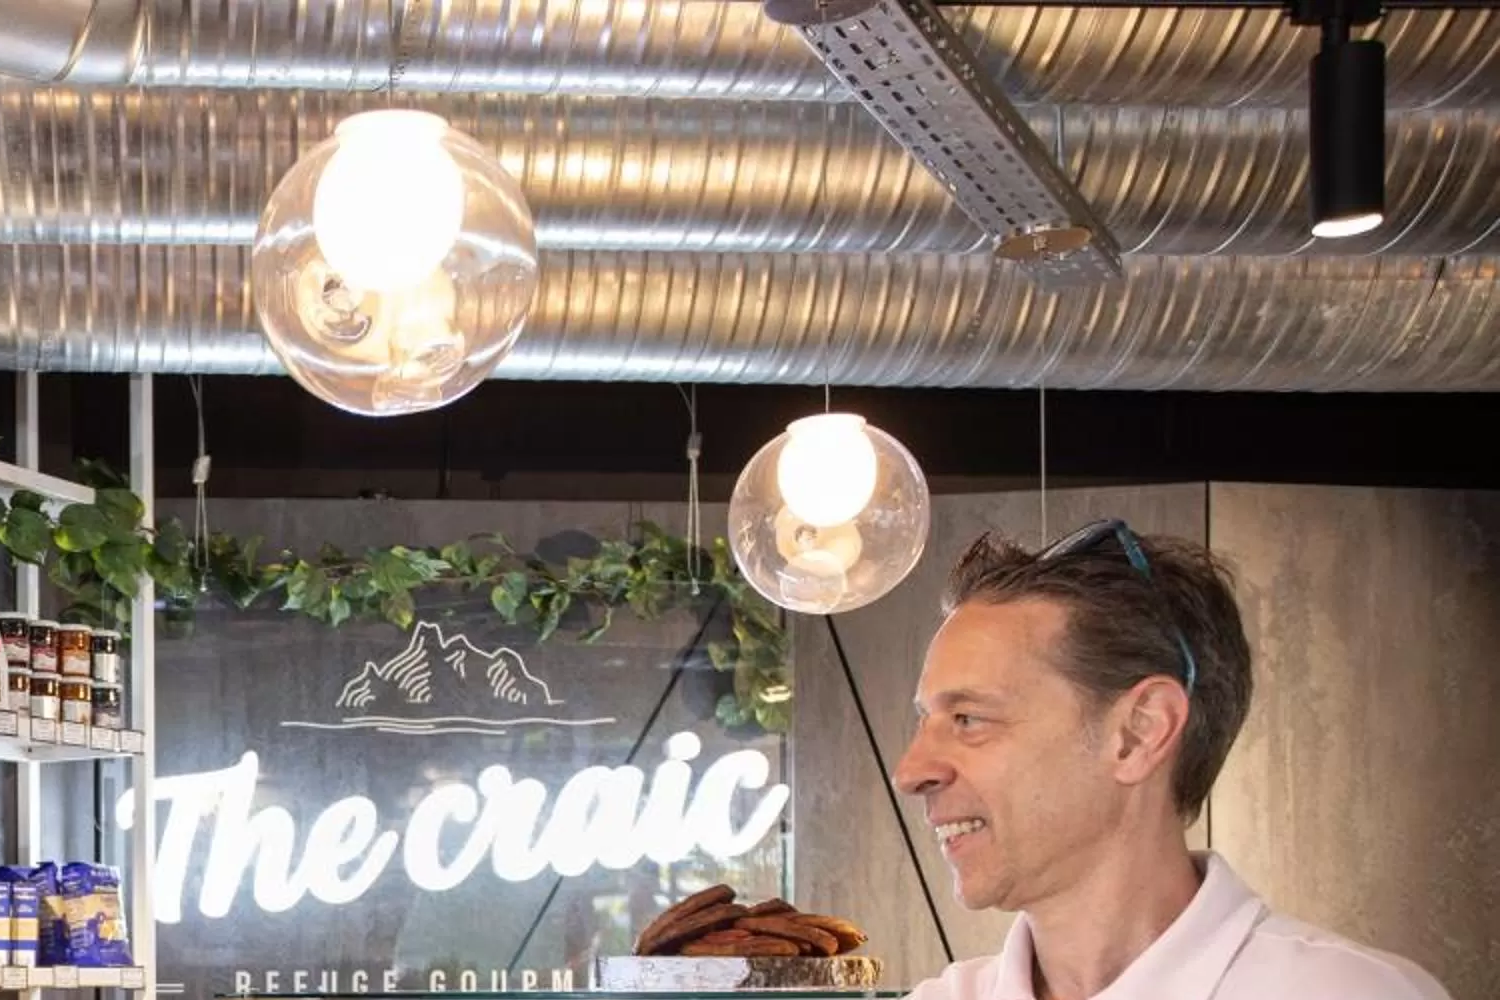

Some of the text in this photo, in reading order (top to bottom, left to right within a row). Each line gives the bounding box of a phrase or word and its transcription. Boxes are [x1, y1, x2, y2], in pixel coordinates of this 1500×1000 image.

[116, 731, 790, 924] The craic
[234, 969, 598, 994] REFUGE GOURM
